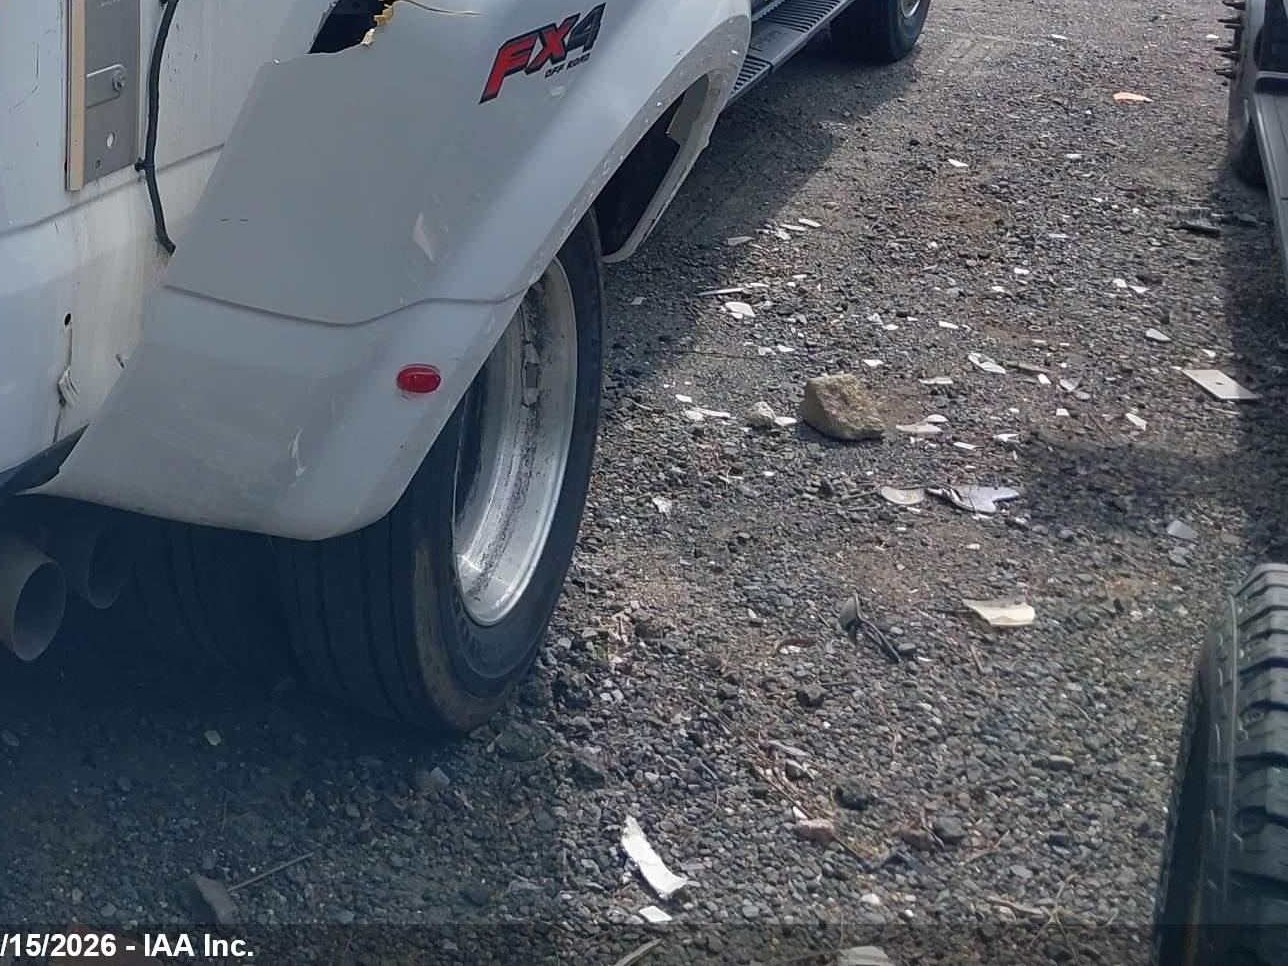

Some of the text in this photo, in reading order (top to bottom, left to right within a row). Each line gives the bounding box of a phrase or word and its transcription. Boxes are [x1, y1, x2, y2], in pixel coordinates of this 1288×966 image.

[479, 2, 607, 105] FX4
[544, 52, 591, 78] OFF ROAD
